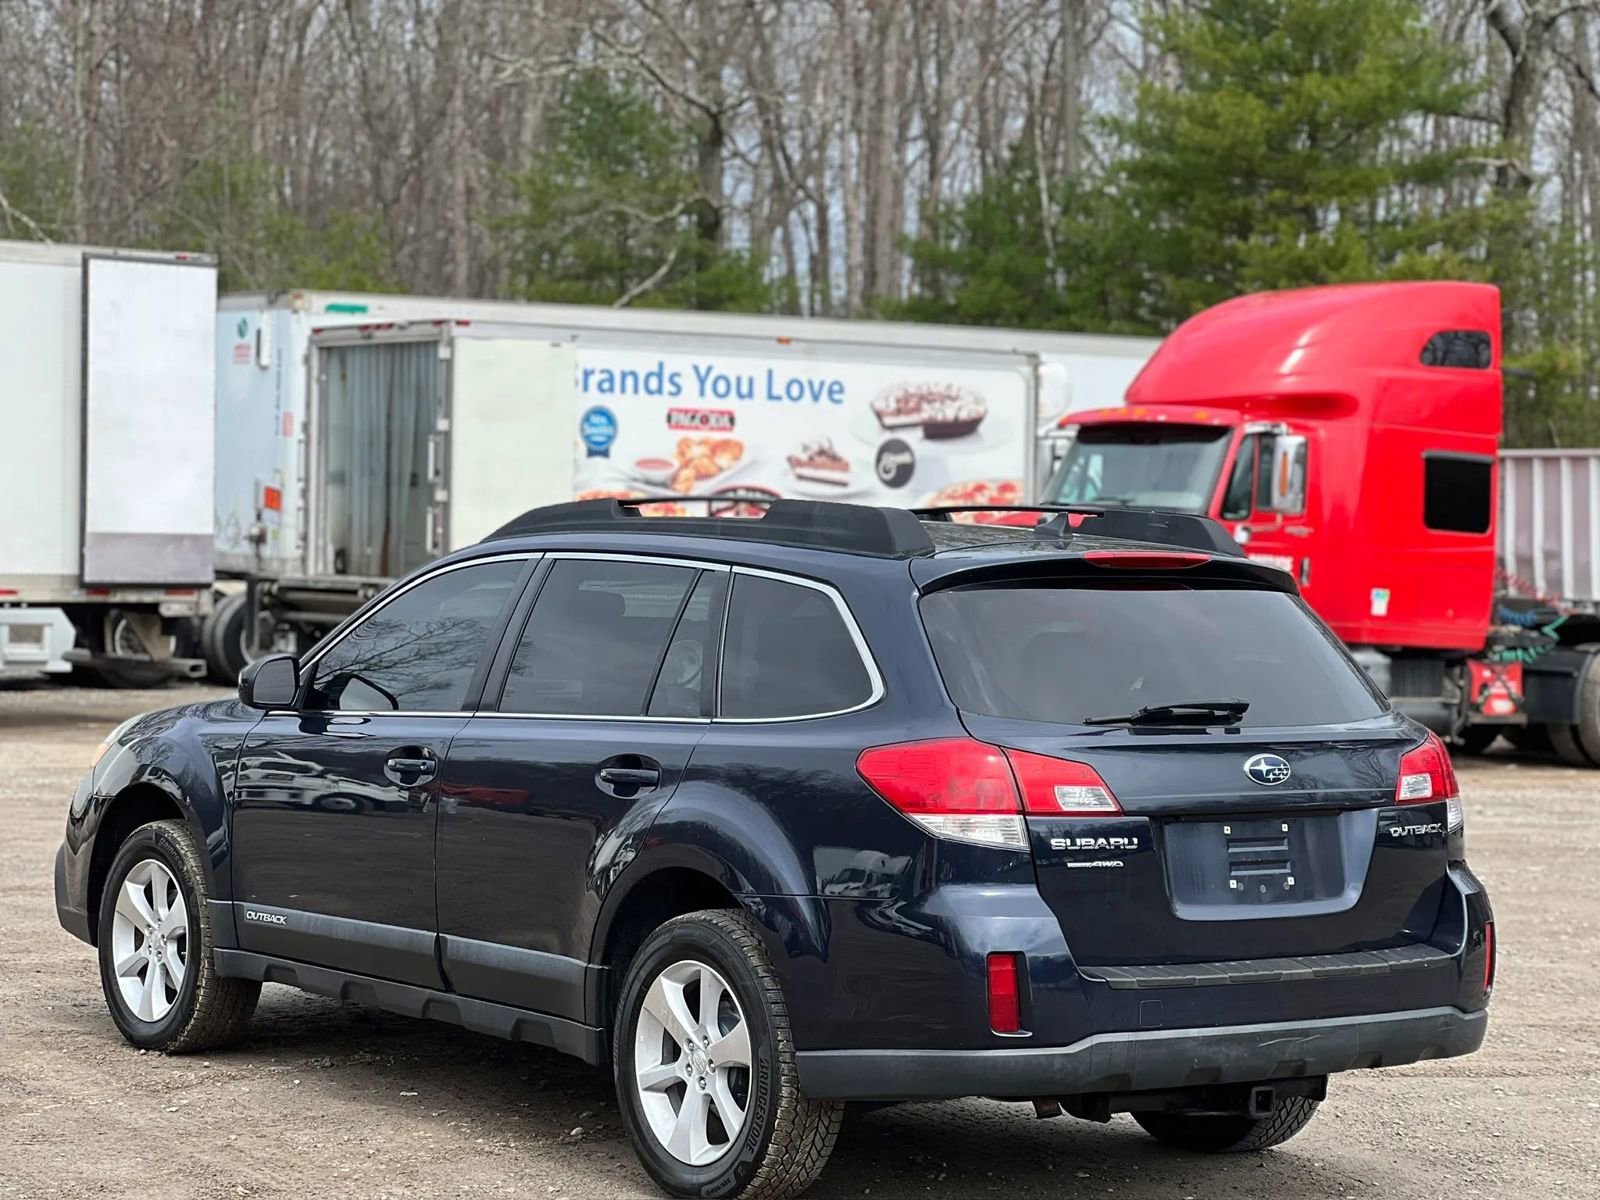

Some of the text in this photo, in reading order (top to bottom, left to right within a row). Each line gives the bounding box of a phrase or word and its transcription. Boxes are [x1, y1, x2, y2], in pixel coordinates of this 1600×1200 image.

[576, 361, 845, 404] rands You Love
[1389, 822, 1442, 838] OUTBACK
[1050, 837, 1138, 850] SUBARU
[1089, 860, 1124, 868] AWD
[246, 910, 288, 925] OUTBACK
[745, 1057, 769, 1155] BRIDGESTONE
